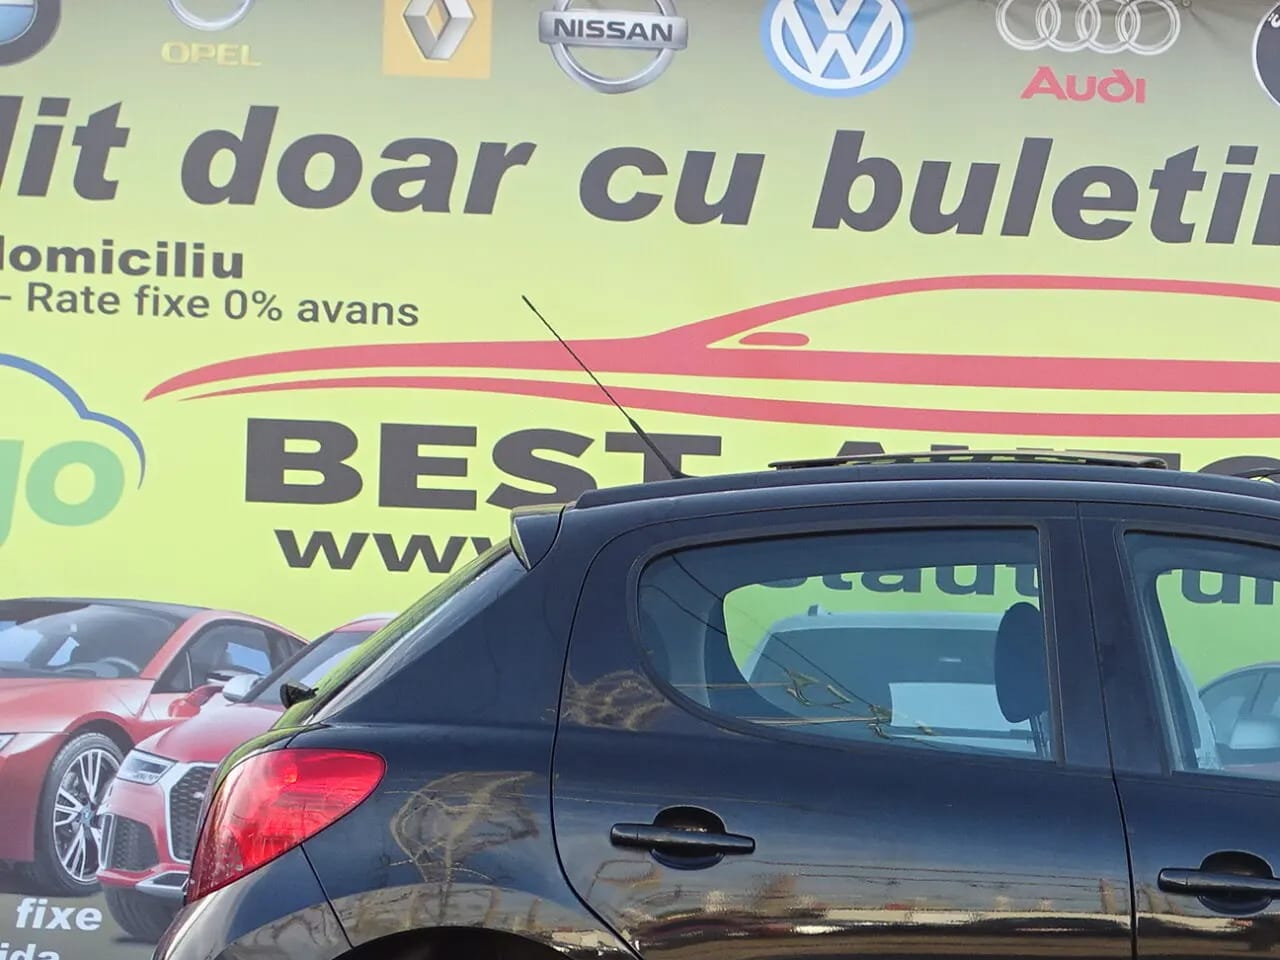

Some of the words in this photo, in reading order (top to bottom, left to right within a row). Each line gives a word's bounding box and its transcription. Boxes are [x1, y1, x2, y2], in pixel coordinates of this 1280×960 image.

[553, 17, 674, 43] NISSAN
[160, 41, 262, 67] OPEL
[1020, 66, 1146, 104] Audi
[180, 106, 537, 215] doar
[578, 145, 766, 226] cu
[0, 235, 245, 279] omiciliu
[27, 282, 121, 315] Rate
[135, 284, 210, 319] fixe
[223, 289, 283, 322] 0%
[297, 296, 420, 327] avans
[245, 418, 722, 511] BEST
[16, 897, 103, 931] fixe
